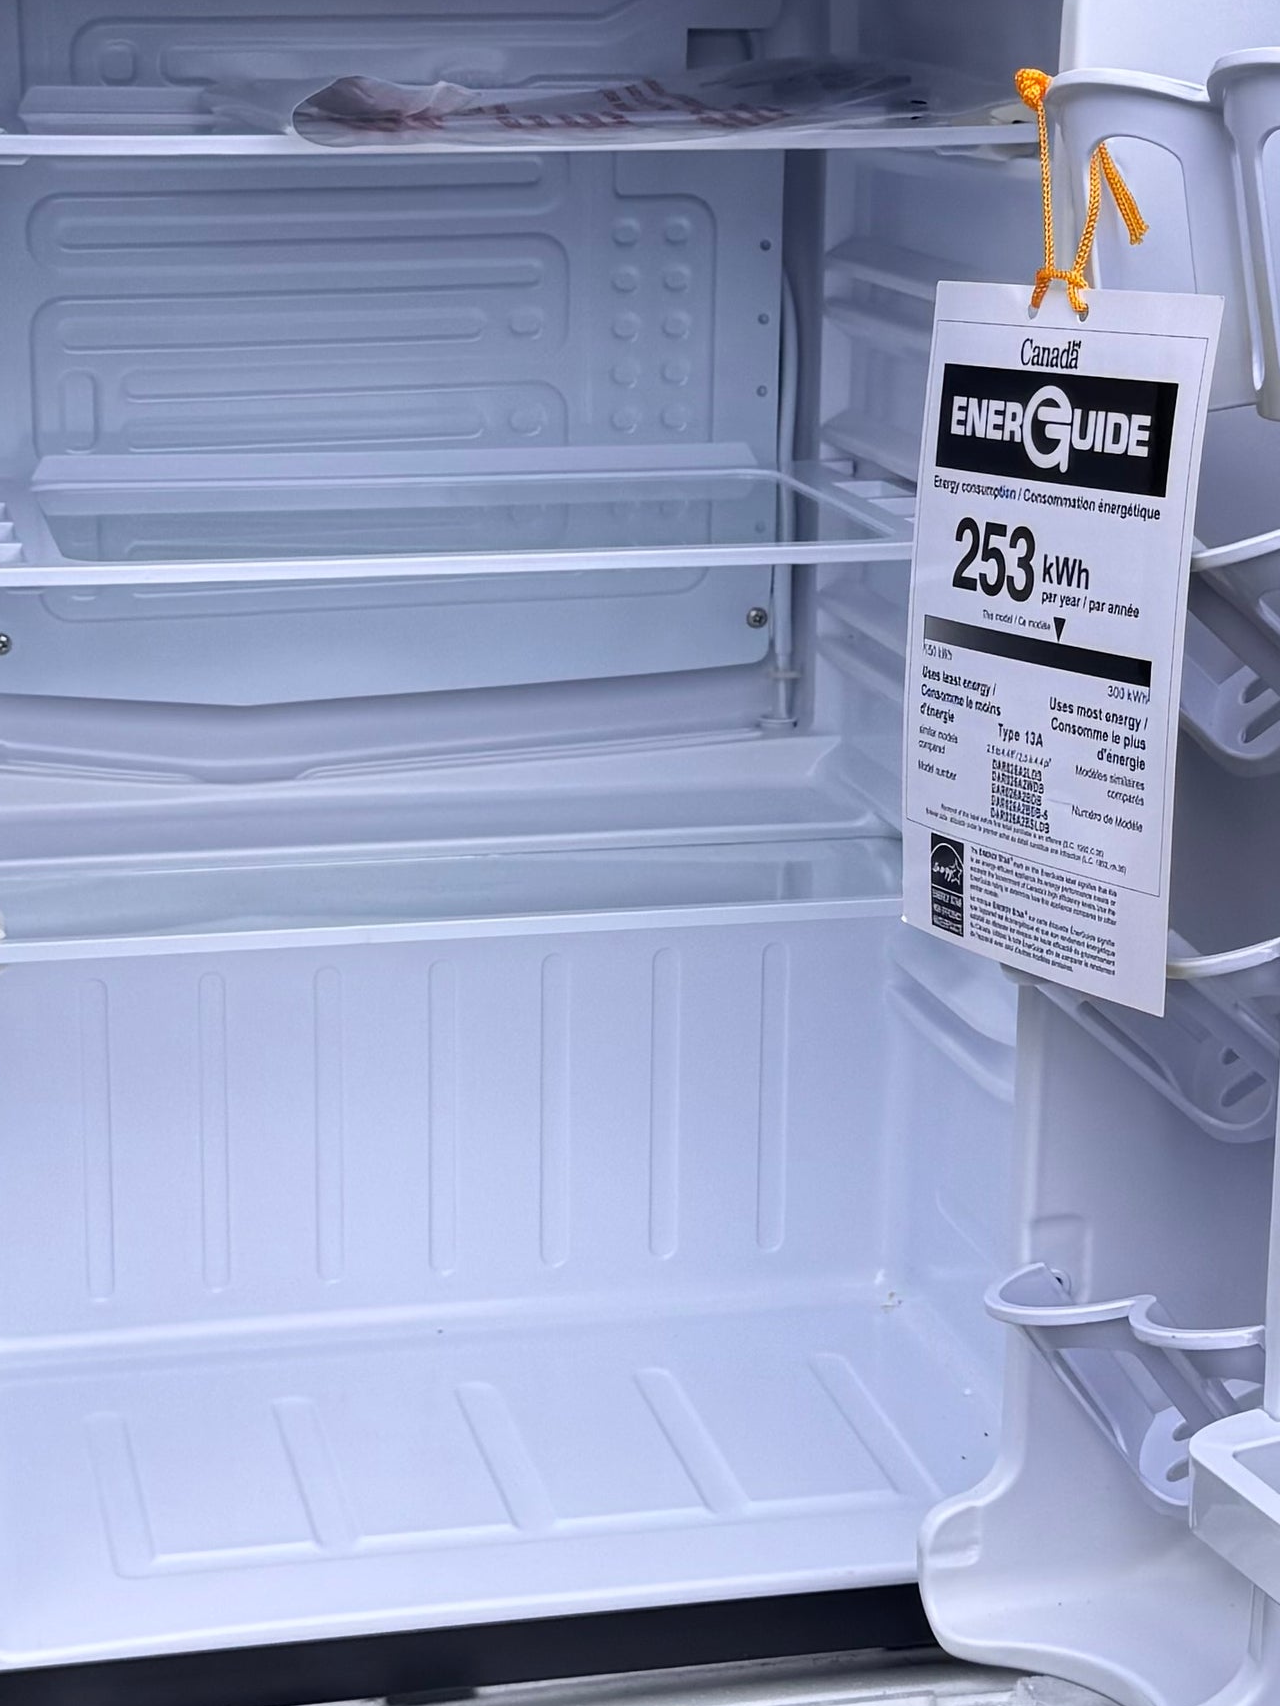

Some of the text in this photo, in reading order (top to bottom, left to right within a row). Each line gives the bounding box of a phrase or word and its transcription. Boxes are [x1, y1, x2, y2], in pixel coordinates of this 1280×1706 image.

[1020, 338, 1081, 370] Canada
[950, 384, 1152, 474] ENERGUIDE
[933, 474, 961, 495] Energy
[961, 478, 1017, 501] consumption
[1023, 488, 1096, 512] Consommation
[1097, 498, 1161, 521] énergétique
[951, 516, 1090, 603] 253 kWh
[1058, 593, 1081, 609] year
[1107, 602, 1140, 619] année
[1049, 696, 1074, 714] Uses
[1076, 704, 1104, 722] most
[1105, 712, 1142, 733] energy
[998, 722, 1044, 748] Type 13A
[1050, 716, 1147, 751] Consomme le plus
